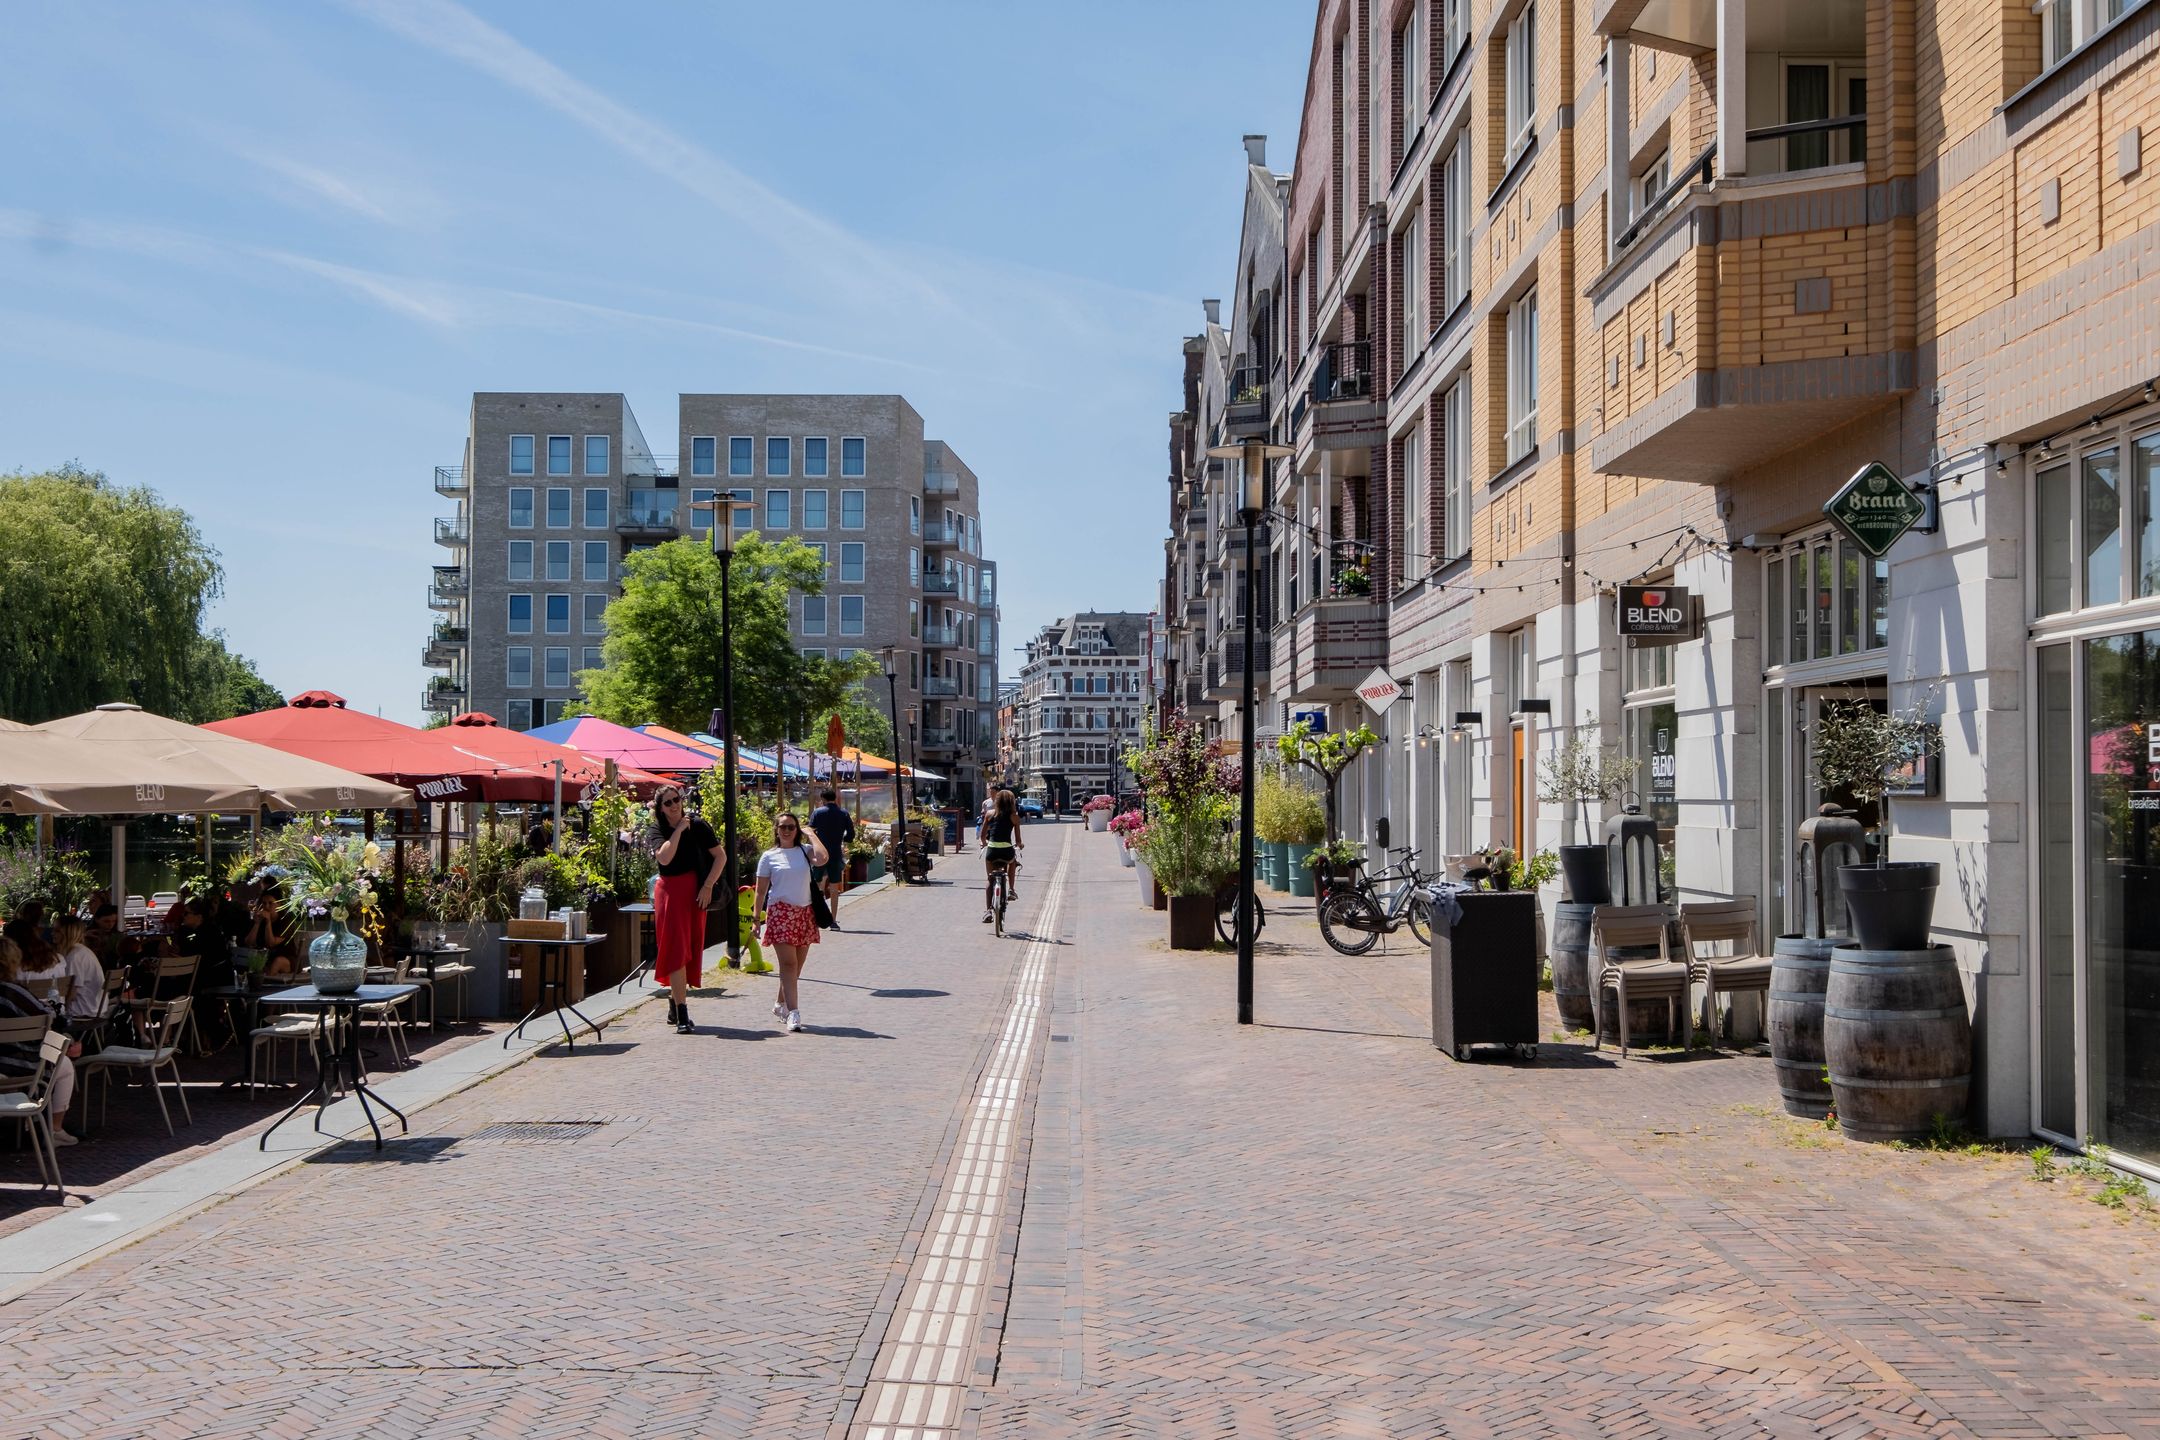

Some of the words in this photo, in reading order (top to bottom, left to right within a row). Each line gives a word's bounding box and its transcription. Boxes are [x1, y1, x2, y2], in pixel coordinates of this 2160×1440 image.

[1849, 491, 1907, 511] Brand
[1627, 608, 1683, 623] BLEND
[1631, 623, 1655, 631] coffee
[1661, 623, 1678, 631] wine
[1360, 683, 1399, 700] PUBLIEK
[1652, 755, 1675, 777] BLEND
[136, 784, 165, 801] BLEND
[416, 776, 468, 799] PUBLIEK
[2128, 797, 2160, 809] breakfast
